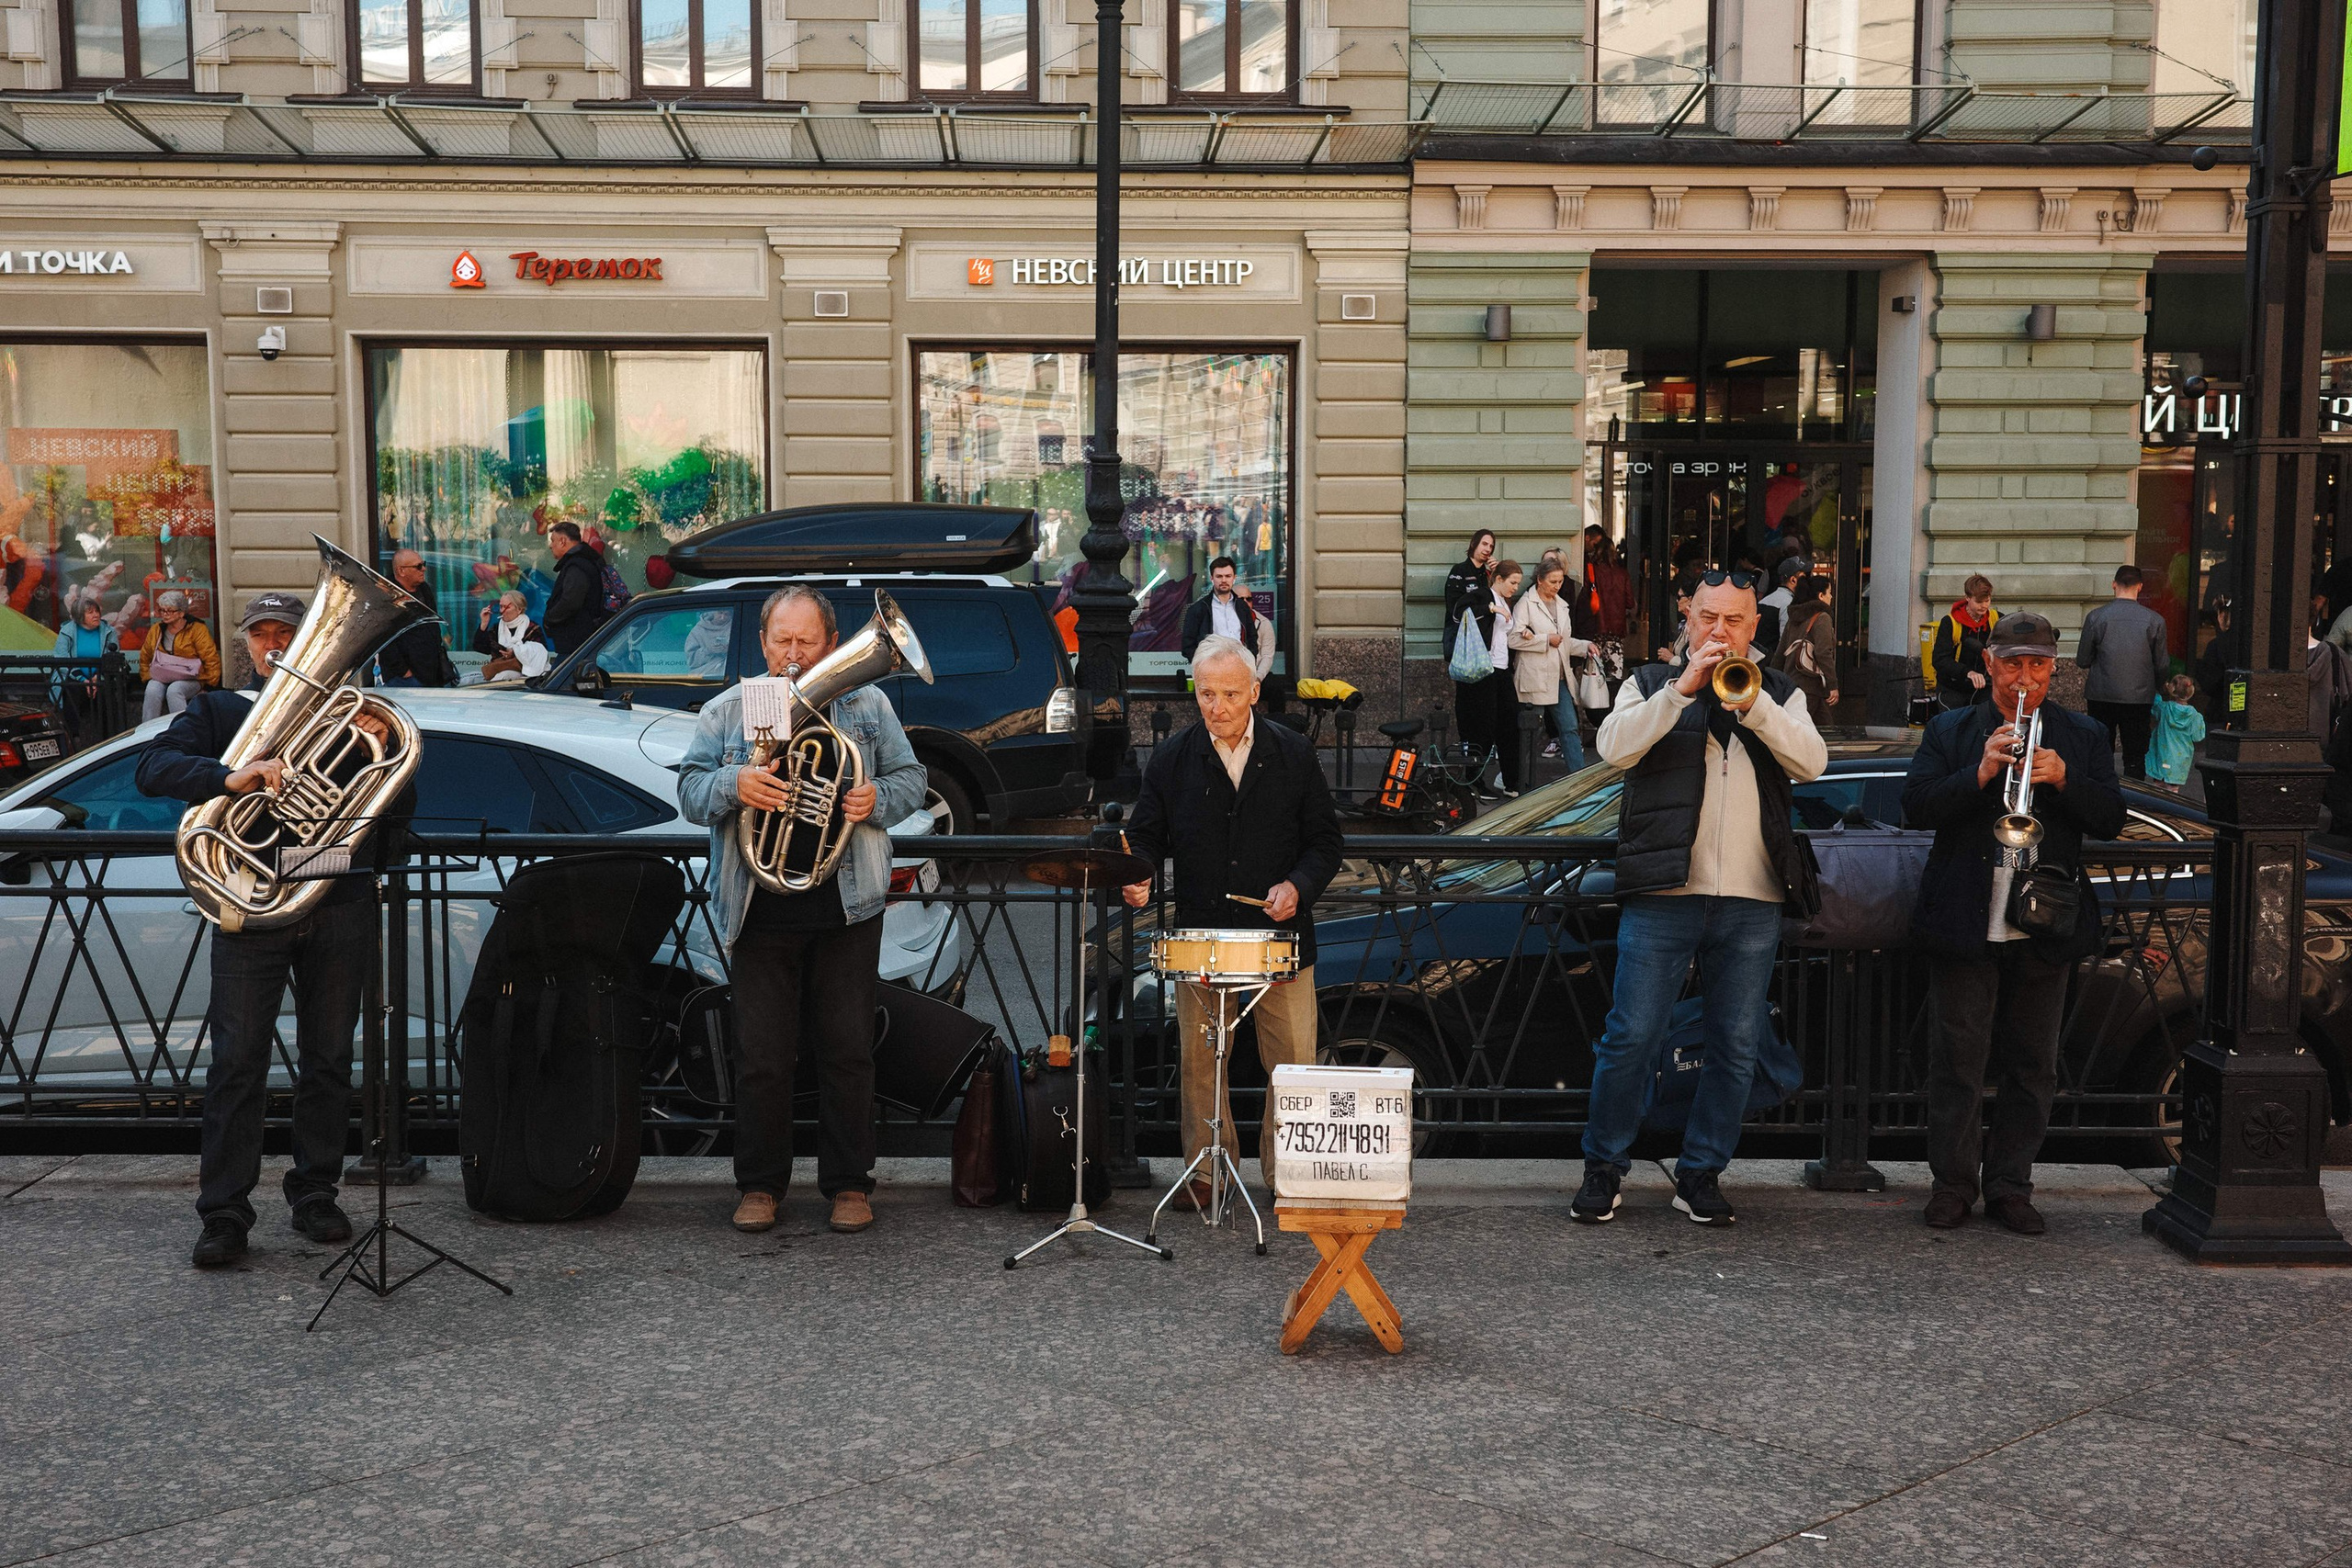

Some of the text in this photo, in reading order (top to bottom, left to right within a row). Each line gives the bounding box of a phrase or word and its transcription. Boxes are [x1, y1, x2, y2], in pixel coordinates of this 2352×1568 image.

[21, 250, 134, 274] ТОЧКА
[508, 251, 664, 286] Теремок
[1163, 259, 1254, 289] ЦЕНТР
[1280, 1096, 1313, 1111] СБЕР
[1375, 1097, 1403, 1114] ВТБ
[1313, 1161, 1356, 1181] ПАВЕЛ
